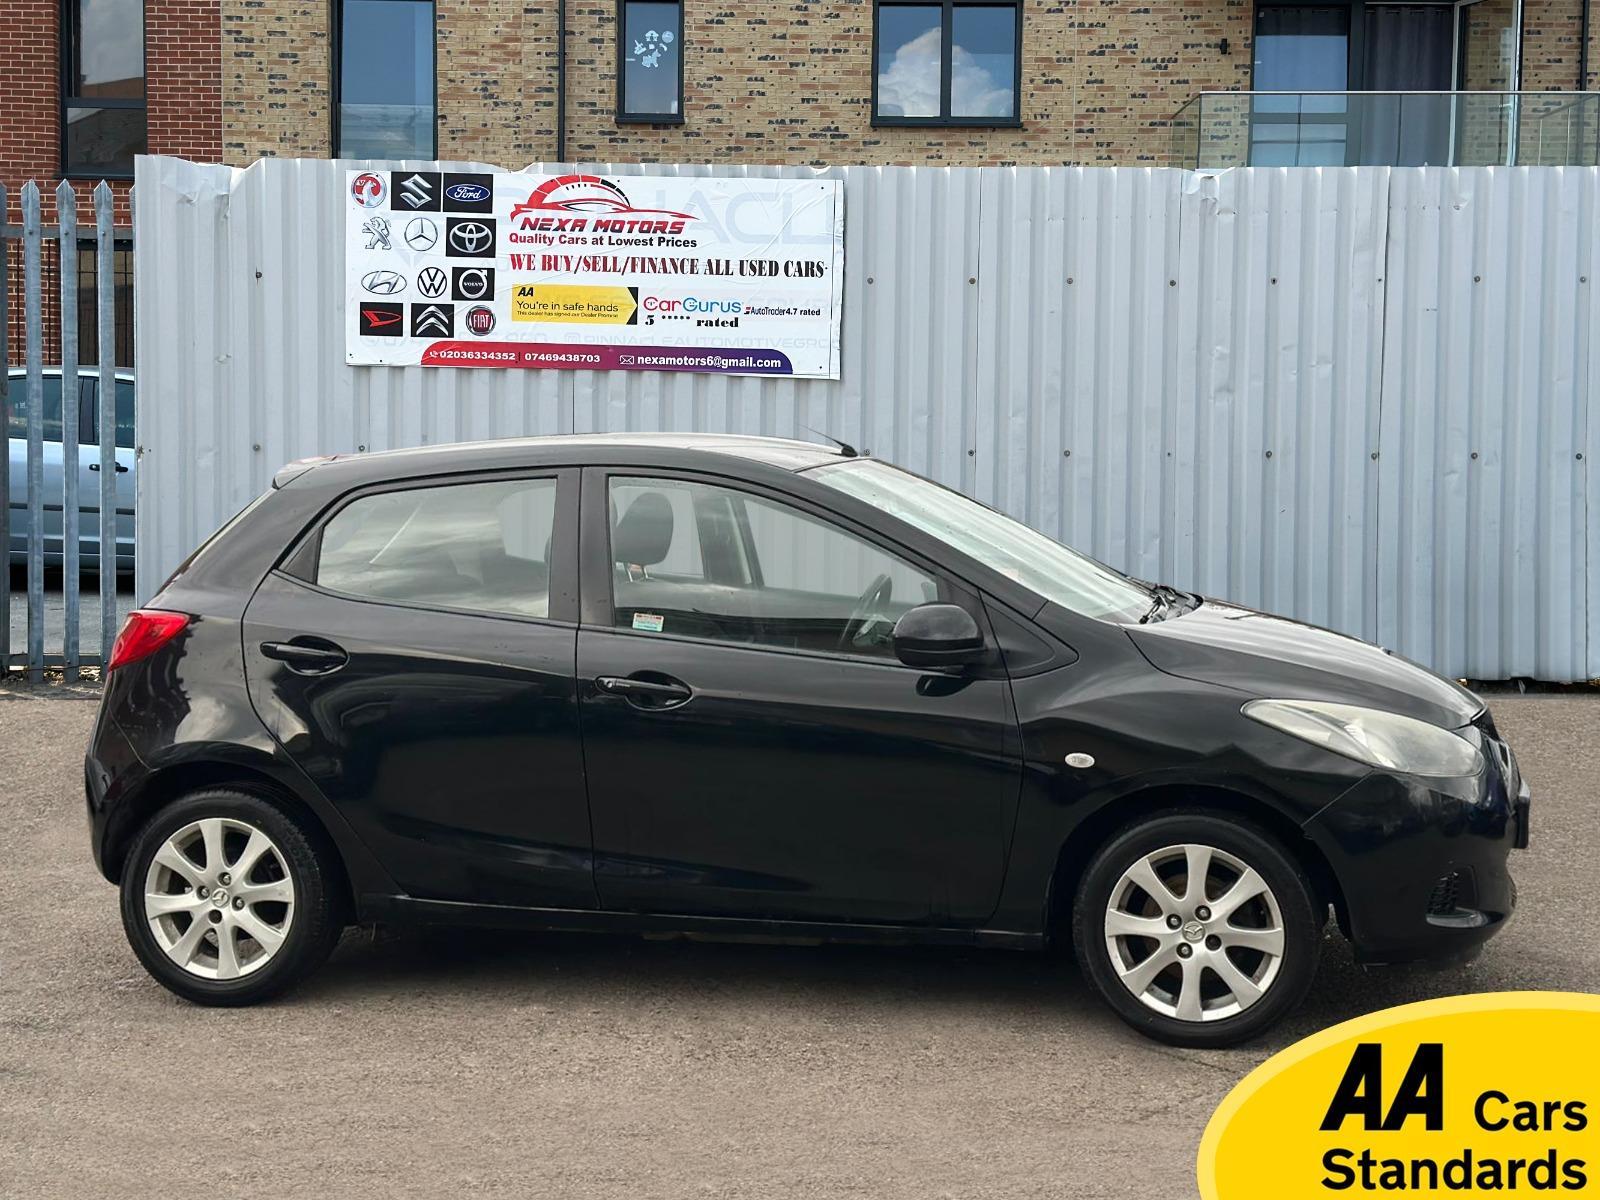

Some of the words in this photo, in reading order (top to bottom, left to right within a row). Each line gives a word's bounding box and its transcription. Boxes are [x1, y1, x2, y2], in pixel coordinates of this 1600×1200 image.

[454, 186, 482, 200] Ford
[520, 217, 588, 232] NEXA
[592, 219, 686, 235] MOTORS
[508, 232, 555, 247] Quality
[559, 234, 588, 246] Cars
[591, 236, 604, 246] at
[608, 236, 654, 247] Lowest
[657, 237, 698, 248] Prices
[509, 253, 536, 271] WE
[541, 254, 699, 276] BUY/SELL/FINANCE
[704, 258, 734, 276] ALL
[739, 260, 780, 277] USED
[783, 260, 825, 278] CARS
[517, 286, 534, 297] AA
[516, 300, 549, 310] You're
[551, 301, 561, 310] in
[562, 302, 585, 311] safe
[587, 303, 619, 312] hands
[643, 296, 742, 313] CarGurus
[799, 308, 821, 316] rated
[473, 314, 490, 328] FIAT
[644, 314, 655, 326] 5
[696, 317, 740, 328] rated
[439, 351, 516, 362] 02036334352
[524, 352, 601, 363] 07469438703
[637, 355, 782, 369] nexamotors6@gmail.com
